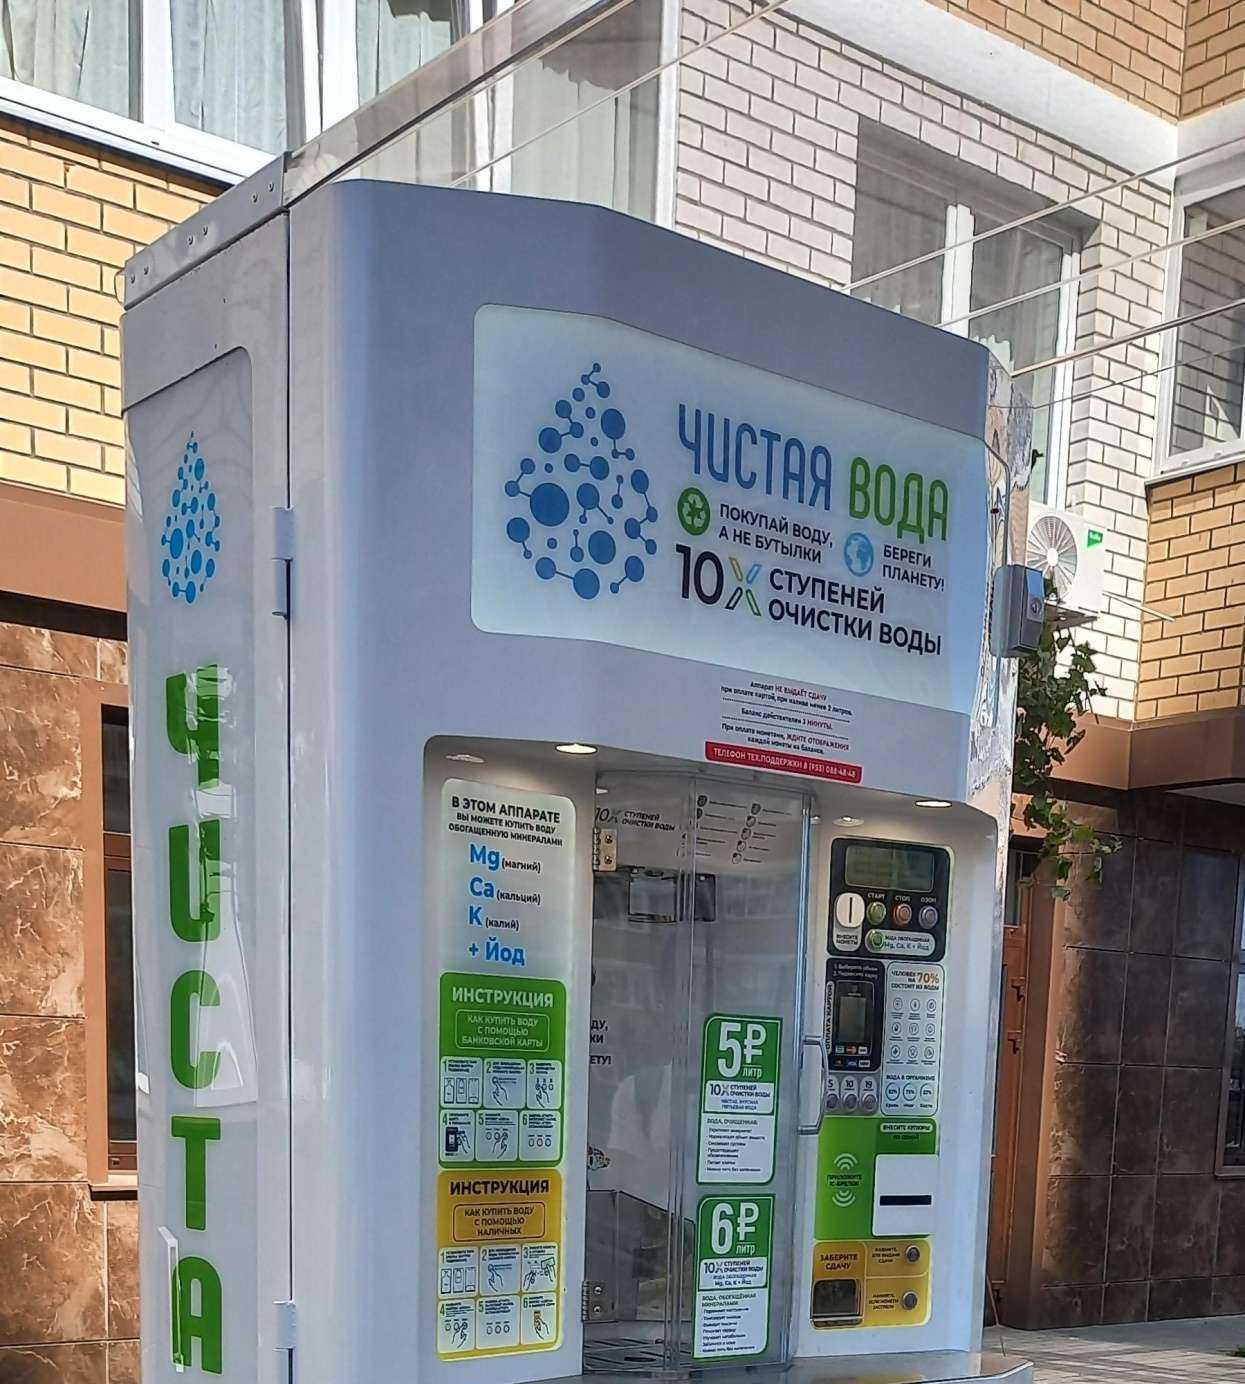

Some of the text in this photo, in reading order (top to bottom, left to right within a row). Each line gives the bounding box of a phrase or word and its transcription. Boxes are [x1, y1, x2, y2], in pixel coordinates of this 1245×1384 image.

[679, 403, 948, 544] ЧИСТАЯ ВОДА
[720, 504, 833, 548] ПОКУПАЙ ВОДУ,
[719, 526, 822, 564] А НЕ БУТЫЛКИ
[884, 544, 931, 568] БЕРЕГИ
[883, 564, 945, 592] ПЛАНЕТУ!
[769, 568, 885, 614] СТУПЕНЕЙ
[768, 598, 941, 655] ОЧИСТКИ ВОДЫ
[714, 748, 746, 760] ТЕЛЕФОН
[452, 795, 560, 824] В ЭТОМ АППАРАТЕ
[457, 812, 556, 834] ВЫ МОЖЕТЕ КУПИТЬ ВОДУ
[448, 823, 563, 847] ОБОГАЩЕННУЮ МИНЕРАЛАМИ
[469, 843, 541, 873] Mg (магний)
[496, 889, 541, 905] (кальций)
[485, 917, 520, 932] (калий)
[485, 937, 525, 966] Йод
[452, 986, 554, 1008] ИНСТРУКЦИЯ
[467, 1015, 539, 1027] КАК КУПИТЬ ВОДУ
[485, 1027, 529, 1037] ПОМОЩЬЮ
[462, 1035, 543, 1048] БАНКОВСКОЙ КАРТЫ
[443, 1060, 448, 1073] 1
[486, 1061, 492, 1074] 2
[529, 1063, 535, 1075] 3
[442, 1113, 448, 1126] 4
[478, 1113, 484, 1126] 5
[522, 1114, 528, 1126] 6
[450, 1179, 550, 1196] ИНСТРУКЦИЯ
[464, 1206, 534, 1217] КАК КУПИТЬ ВОДУ
[474, 1217, 525, 1228] С ПОМОЩЬЮ
[477, 1227, 522, 1237] НАЛИЧНЫХ
[820, 1253, 858, 1262] ЗАБЕРИТЕ
[825, 1261, 851, 1271] СДАЧУ
